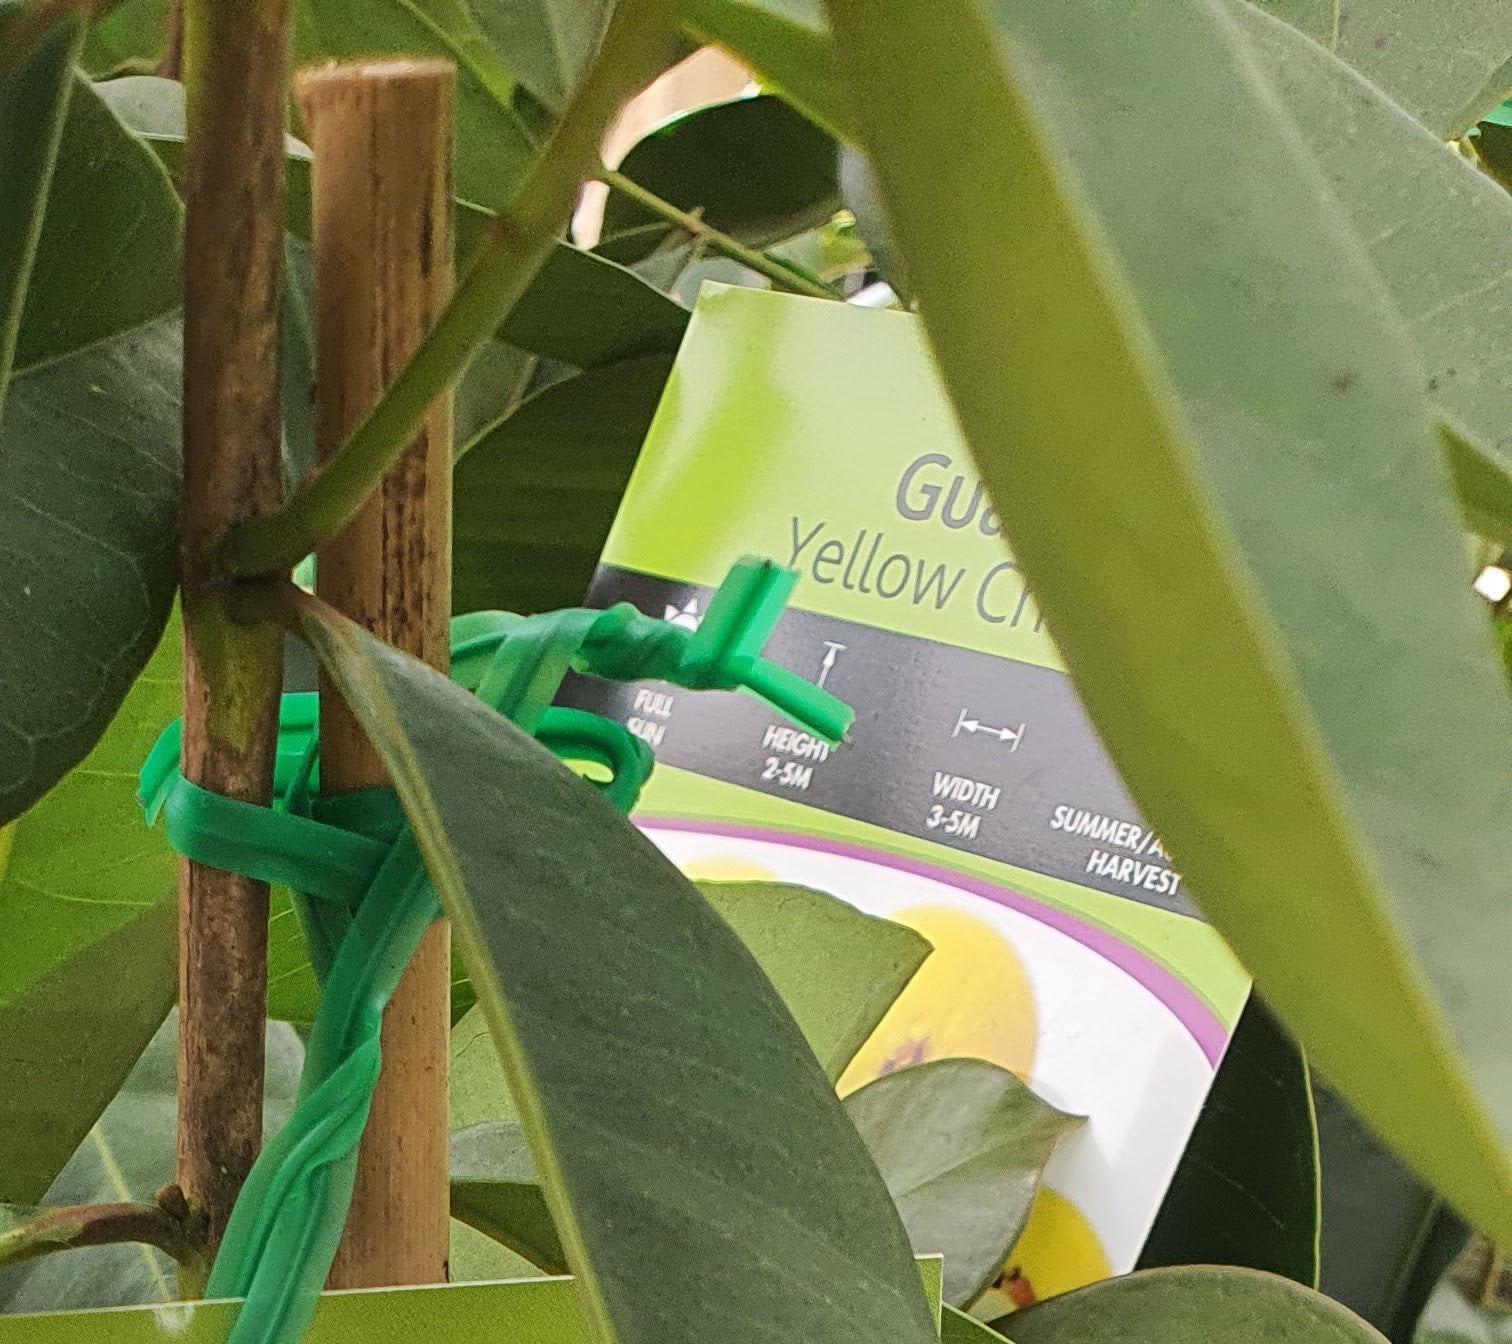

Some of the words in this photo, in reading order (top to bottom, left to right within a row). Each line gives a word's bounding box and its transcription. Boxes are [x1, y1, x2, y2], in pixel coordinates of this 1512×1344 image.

[790, 516, 966, 610] Yellow
[633, 689, 674, 717] FULL
[762, 725, 830, 763] HEIGHT
[760, 756, 814, 790] 2-5M
[932, 771, 1001, 811] WIDTH
[926, 804, 982, 840] 3-5M
[1087, 849, 1183, 897] HARVEST
